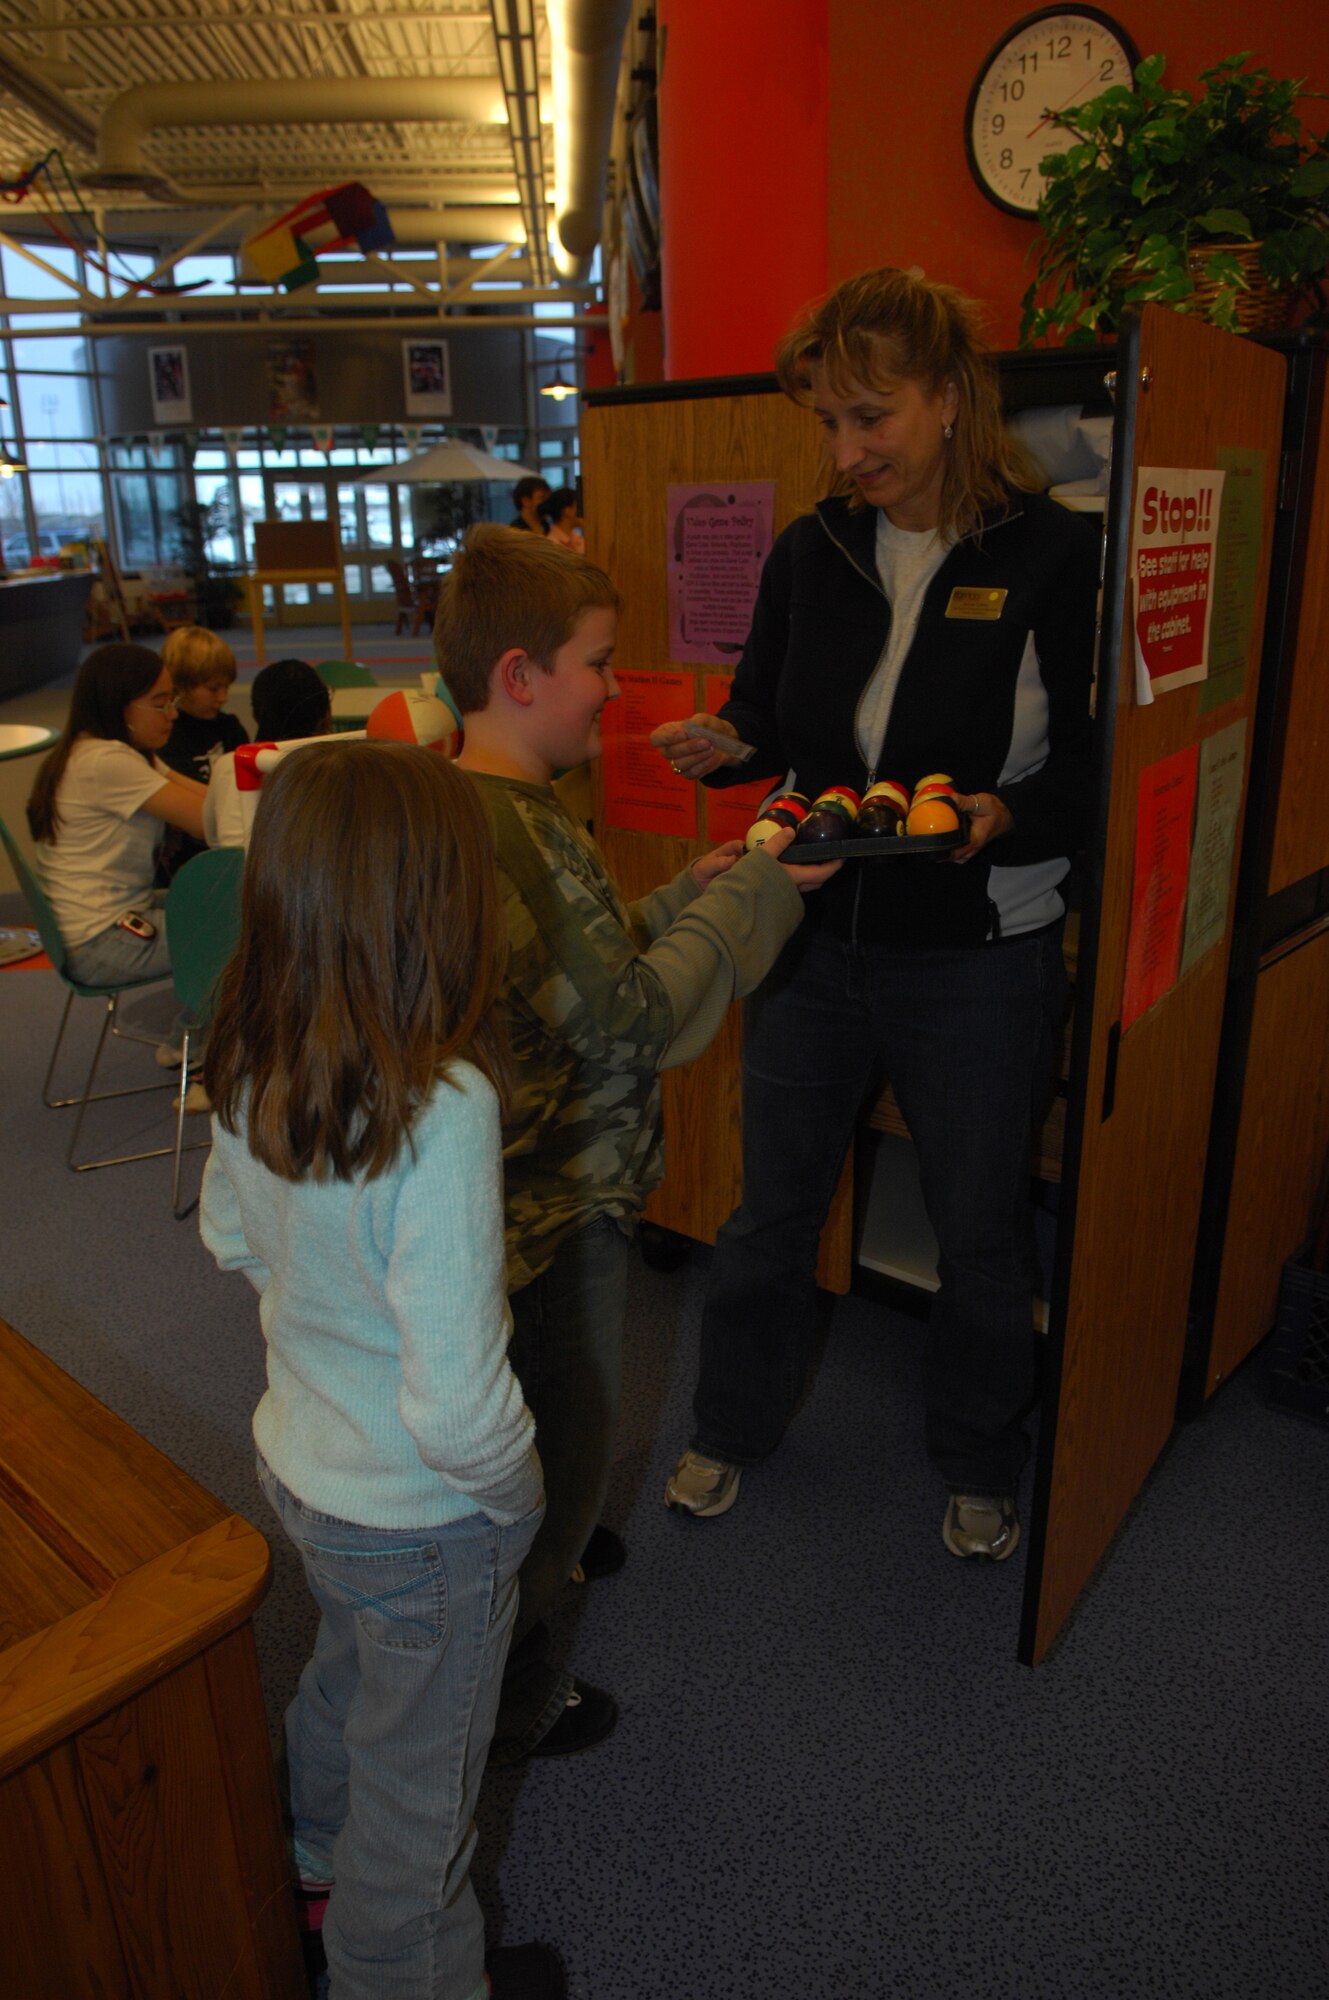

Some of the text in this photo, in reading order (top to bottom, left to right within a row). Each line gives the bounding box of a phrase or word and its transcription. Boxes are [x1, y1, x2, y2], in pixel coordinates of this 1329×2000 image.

[1046, 36, 1072, 60] 12
[1082, 40, 1092, 60] 1
[1018, 53, 1038, 74] 11
[1100, 60, 1114, 82] 2
[1000, 79, 1024, 102] 10
[992, 114, 1005, 136] 9
[1000, 148, 1013, 170] 8
[1019, 168, 1032, 189] 7
[1142, 486, 1212, 544] Stop!!
[1139, 548, 1208, 578] See staff for help
[1140, 578, 1207, 612] with equipment in
[1147, 620, 1161, 644] the
